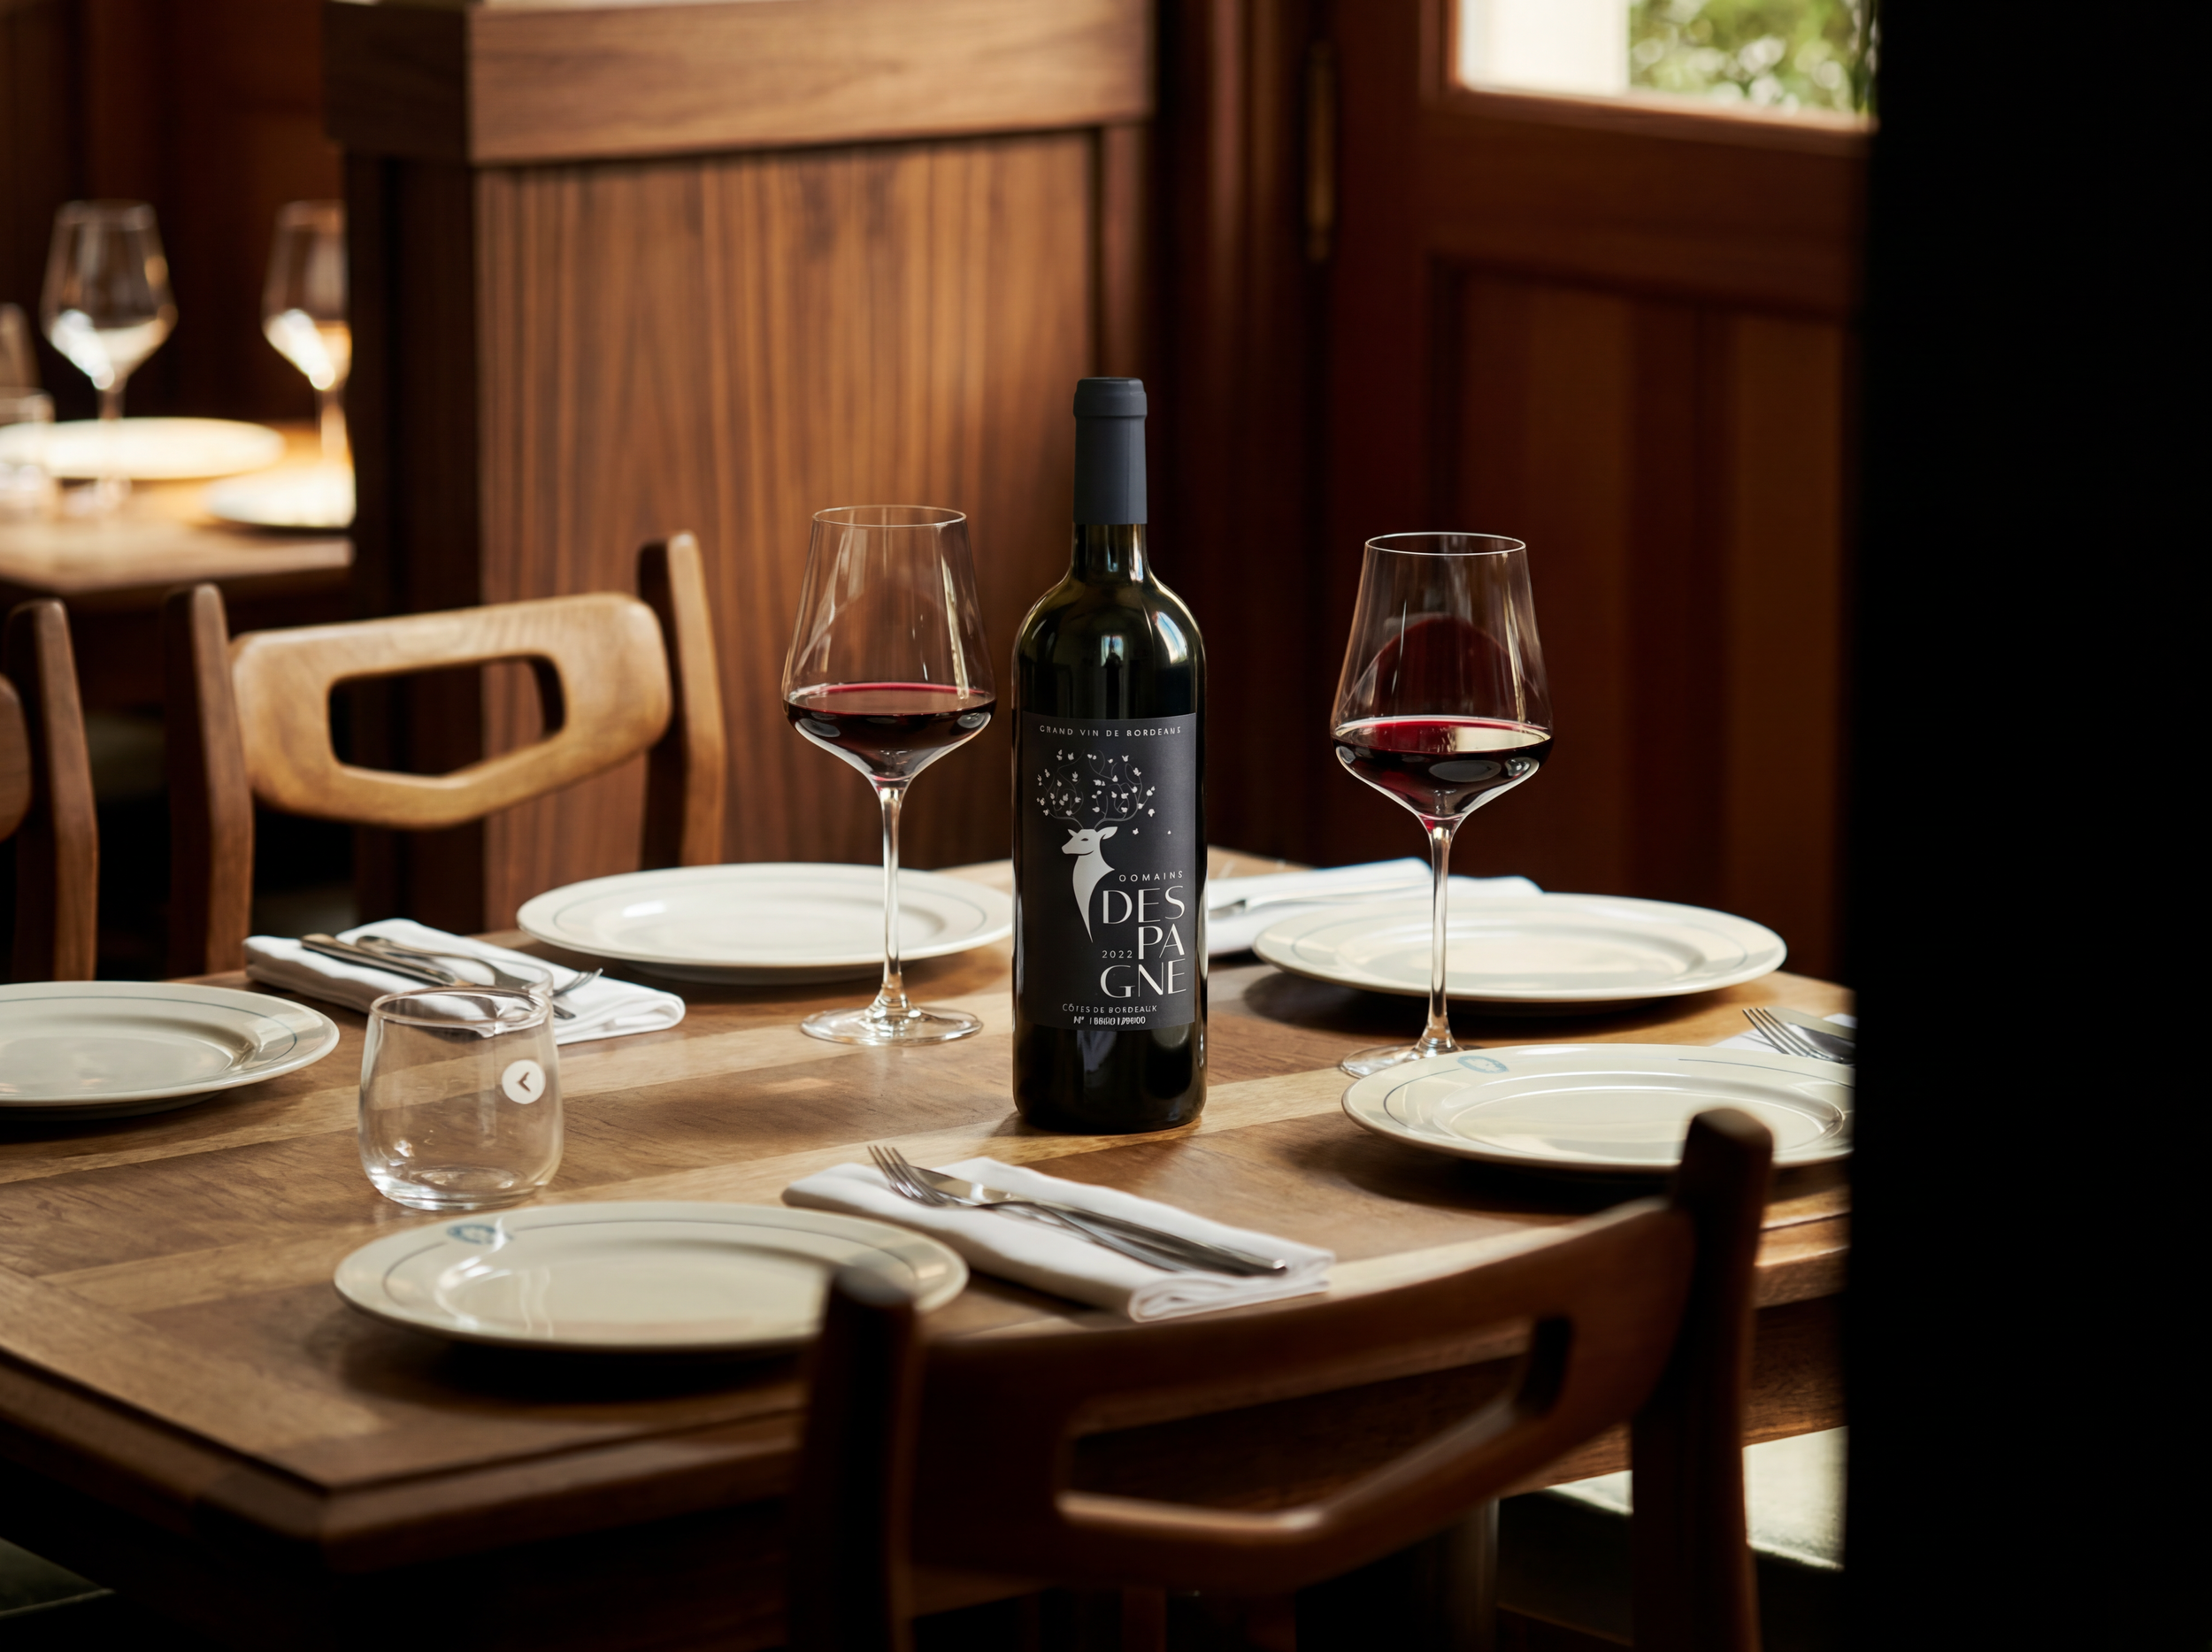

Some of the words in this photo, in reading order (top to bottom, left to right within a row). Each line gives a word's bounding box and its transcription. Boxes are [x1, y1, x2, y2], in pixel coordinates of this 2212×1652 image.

[1079, 728, 1099, 737] VIN
[1102, 885, 1186, 925] DES
[1102, 949, 1133, 959] 2022
[1138, 923, 1186, 960] PA
[1100, 957, 1187, 999] GNE
